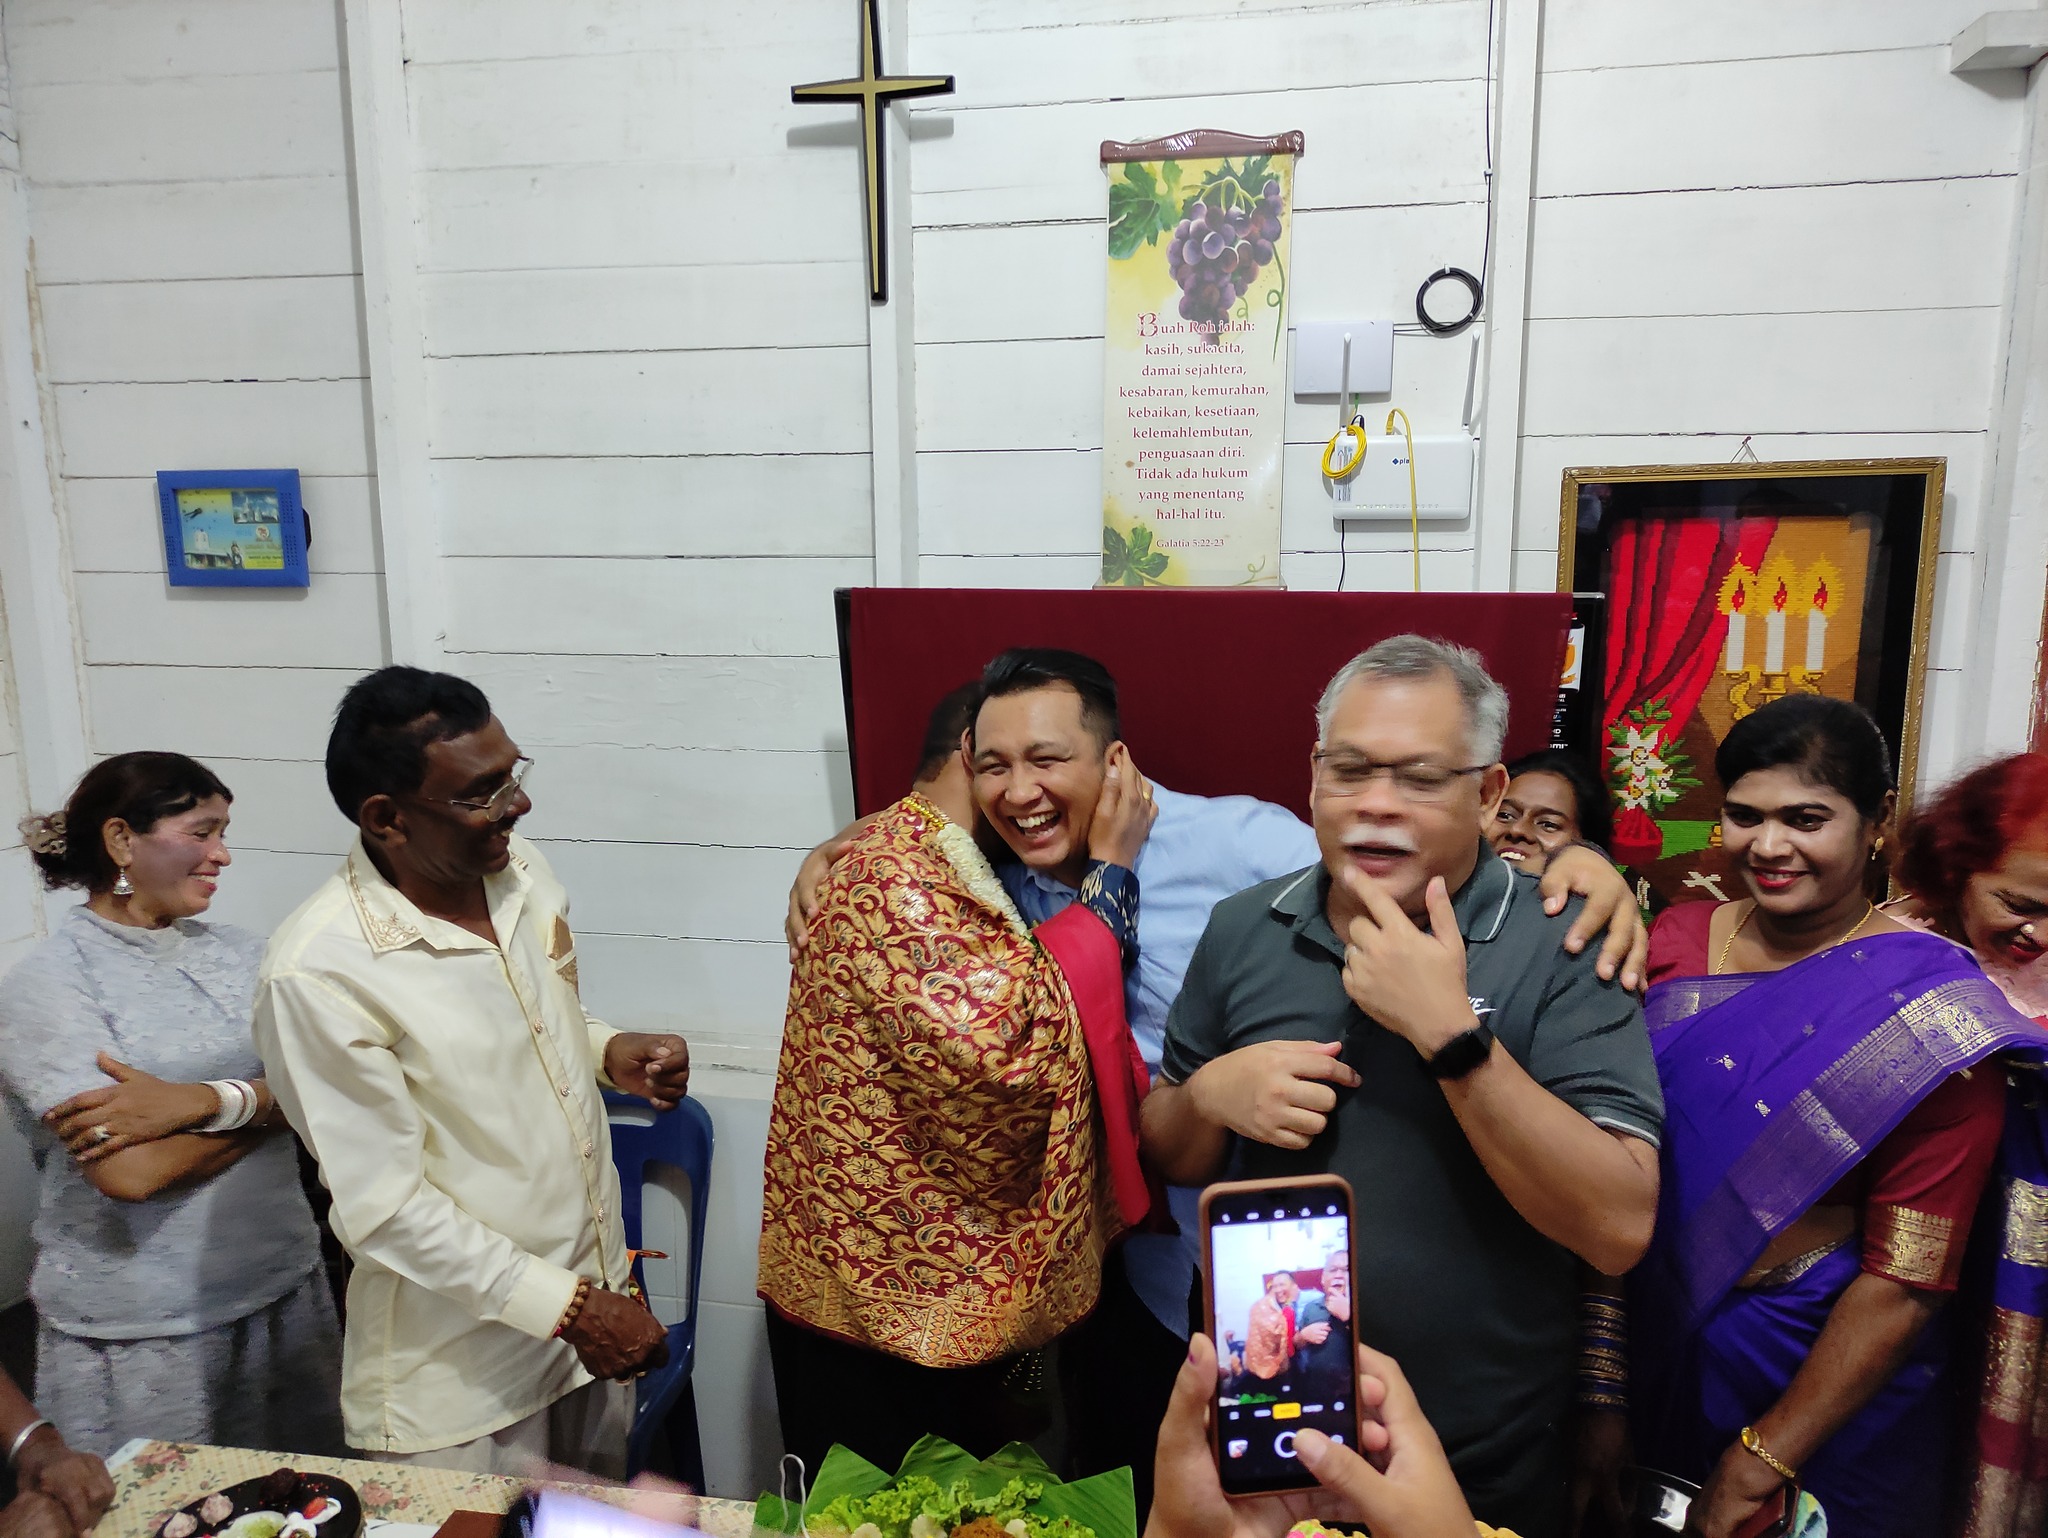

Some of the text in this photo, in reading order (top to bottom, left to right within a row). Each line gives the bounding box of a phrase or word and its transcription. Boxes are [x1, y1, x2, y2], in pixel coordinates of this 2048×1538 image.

[1137, 312, 1255, 336] Buah Roh ialah:
[1145, 342, 1244, 356] kasih, sukacita,
[1142, 364, 1246, 378] damai sejahtera,
[1120, 384, 1269, 398] kesabaran, kemurahan,
[1128, 405, 1259, 419] kebaikan, kesetiaan,
[1133, 426, 1252, 439] kelemahlembutan,
[1139, 447, 1245, 462] penguasaan diri.
[1135, 467, 1247, 479] Tidak ada hukum
[1139, 489, 1244, 503] yang menentang
[1156, 508, 1225, 519] hal-hal itu.
[1157, 539, 1224, 548] Galatia 5:22-23
